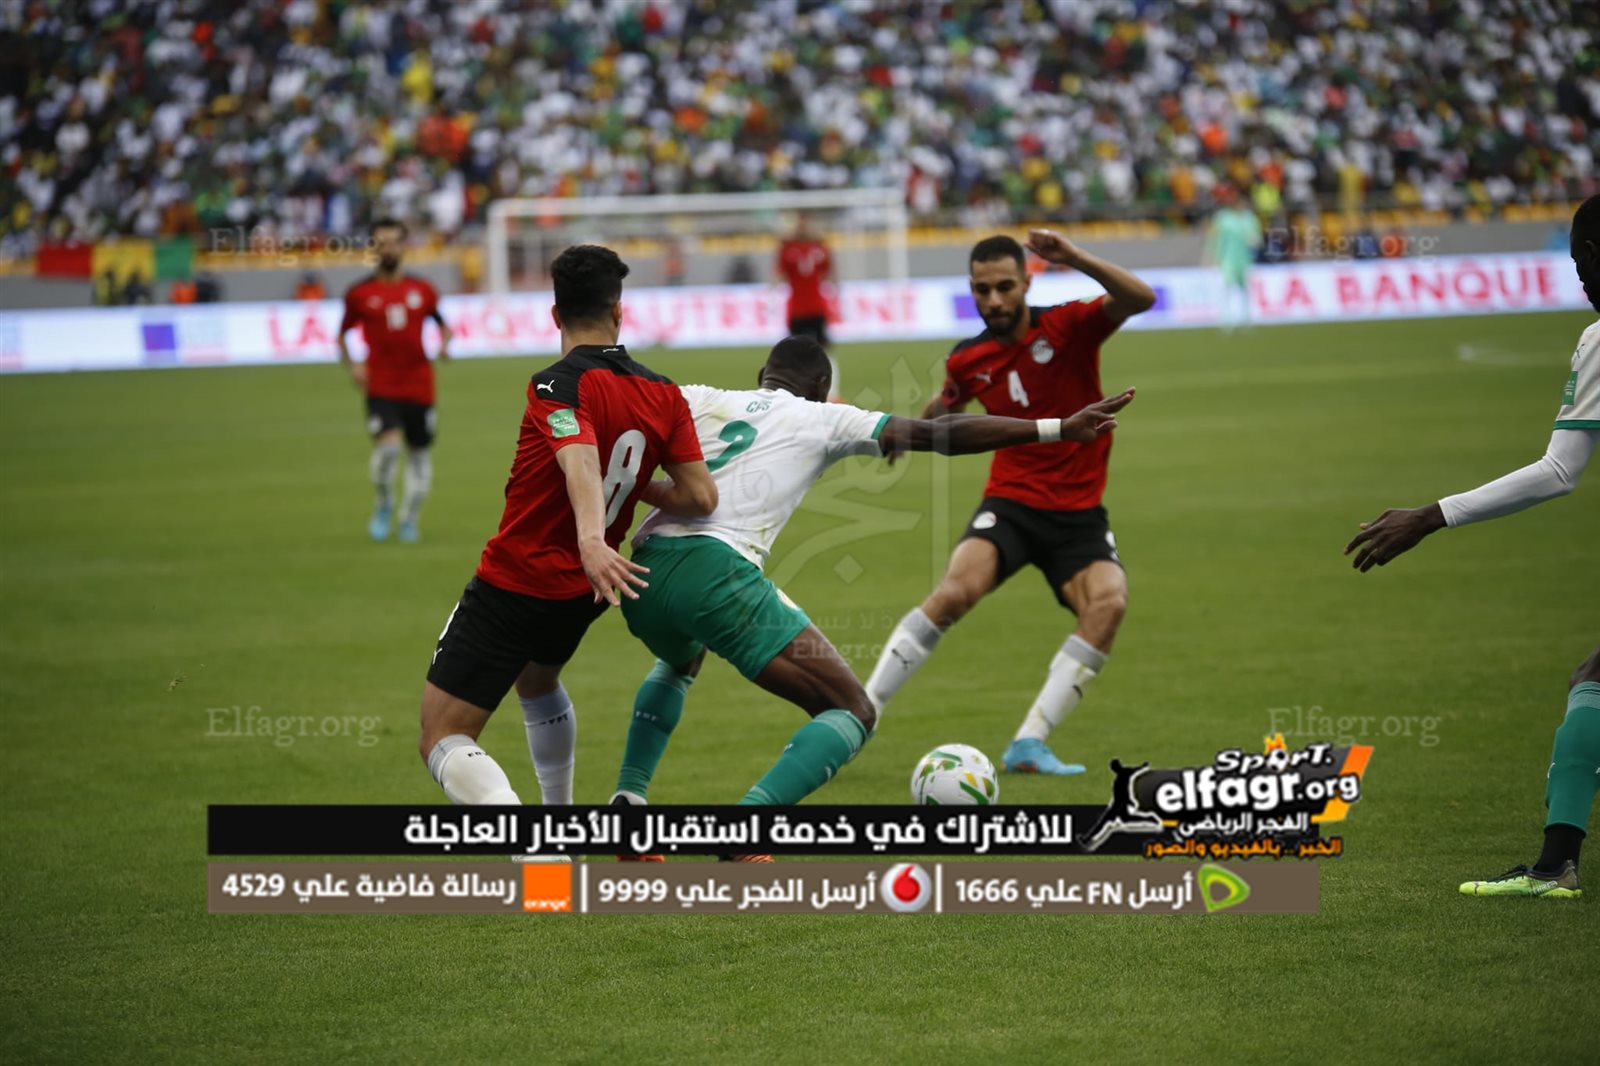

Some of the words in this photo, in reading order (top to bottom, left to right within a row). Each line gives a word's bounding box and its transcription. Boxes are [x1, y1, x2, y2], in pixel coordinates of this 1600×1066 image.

[1254, 276, 1315, 316] LA
[1008, 369, 1030, 409] 4
[602, 429, 647, 529] 8
